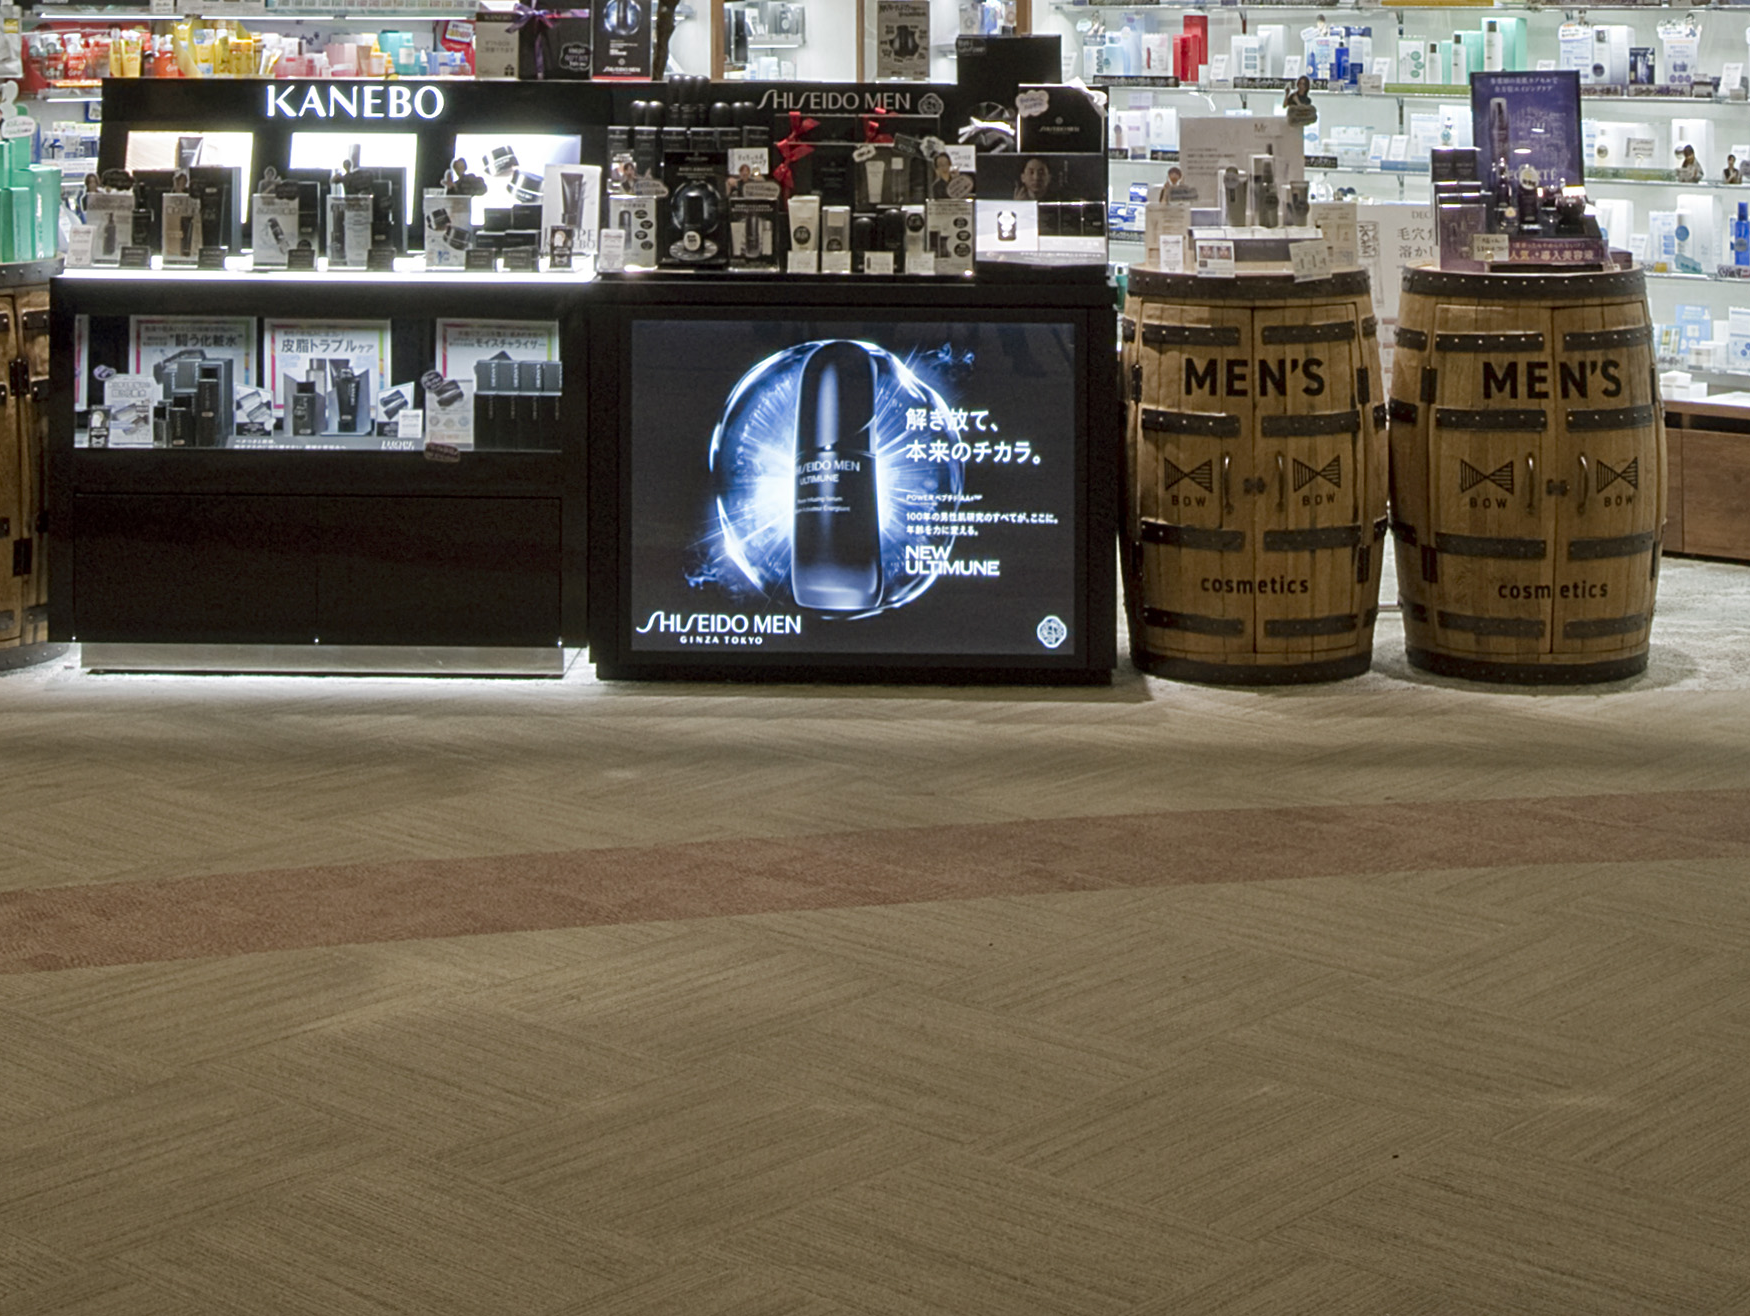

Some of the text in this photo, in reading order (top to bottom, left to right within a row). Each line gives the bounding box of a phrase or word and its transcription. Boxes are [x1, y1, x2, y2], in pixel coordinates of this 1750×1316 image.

[266, 84, 445, 119] KANEBO
[757, 89, 911, 110] SHISEIDO MEN
[281, 338, 374, 354] 皮脂トラブルケア
[475, 338, 547, 349] モイスチャライザー
[1183, 357, 1326, 398] MEN'S
[1481, 359, 1623, 401] MEN'S
[905, 408, 999, 432] 解き放て、
[905, 439, 1041, 466] 本来のチカラ。
[833, 459, 861, 472] MEN
[1170, 494, 1207, 508] BOW
[1301, 491, 1337, 507] BOW
[1469, 495, 1509, 510] BOW
[1603, 493, 1636, 508] BOW
[905, 545, 951, 560] NEW
[905, 560, 1000, 576] ULTIMUNE
[1200, 573, 1310, 597] cosmetics
[1497, 579, 1610, 601] cosmetics
[636, 611, 801, 635] SHISEIDO MEN
[679, 636, 763, 645] GINZA TOKYO
